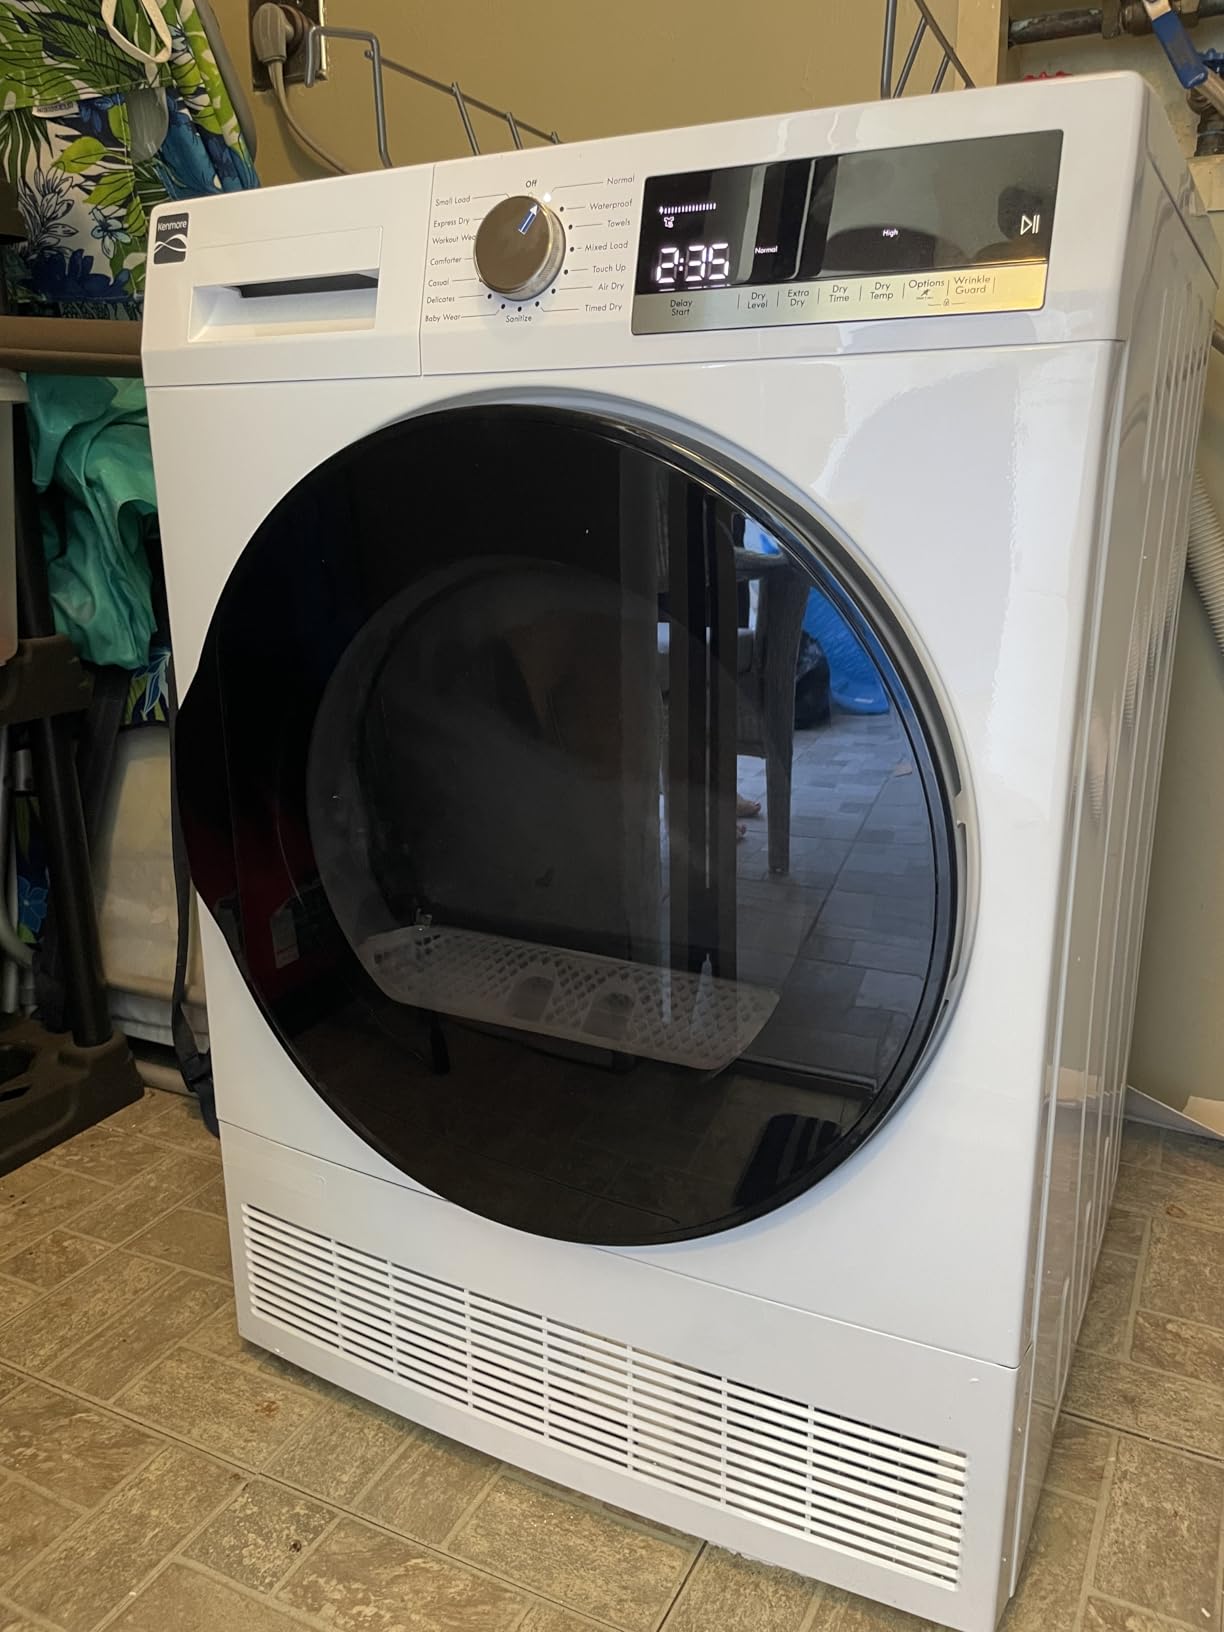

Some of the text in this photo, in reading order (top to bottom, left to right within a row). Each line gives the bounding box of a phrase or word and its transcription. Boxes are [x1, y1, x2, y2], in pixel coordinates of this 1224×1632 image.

[525, 179, 538, 189] Off
[607, 175, 635, 185] Normal
[435, 195, 471, 207] Small Load
[589, 198, 633, 210] Waterproof
[157, 220, 188, 232] Kenmore
[433, 217, 470, 229] Express Dry
[607, 218, 631, 228] Towels
[882, 227, 899, 238] High
[432, 233, 477, 245] Workout Wea
[584, 240, 629, 253] Mixed Load
[754, 245, 778, 254] Normal
[430, 257, 462, 266] Comforter
[656, 243, 729, 283] 2:35
[592, 264, 627, 273] Touch Up
[428, 277, 450, 288] Casual
[908, 279, 945, 291] Options
[953, 275, 991, 285] Wrinkle
[598, 282, 625, 292] Air Dry
[832, 285, 849, 296] Dry
[874, 281, 891, 292] Dry
[955, 285, 987, 295] Guard
[751, 292, 766, 302] Dry
[787, 289, 810, 298] Extra
[829, 294, 850, 303] Time
[870, 292, 894, 302] Temp
[426, 296, 456, 305] Delicates
[670, 299, 693, 310] Delay
[747, 300, 769, 310] Level
[790, 298, 806, 309] Dry
[585, 303, 623, 312] Timed Dry
[671, 308, 690, 317] Start
[425, 313, 461, 323] Baby Wear
[505, 314, 533, 324] Sanitize
